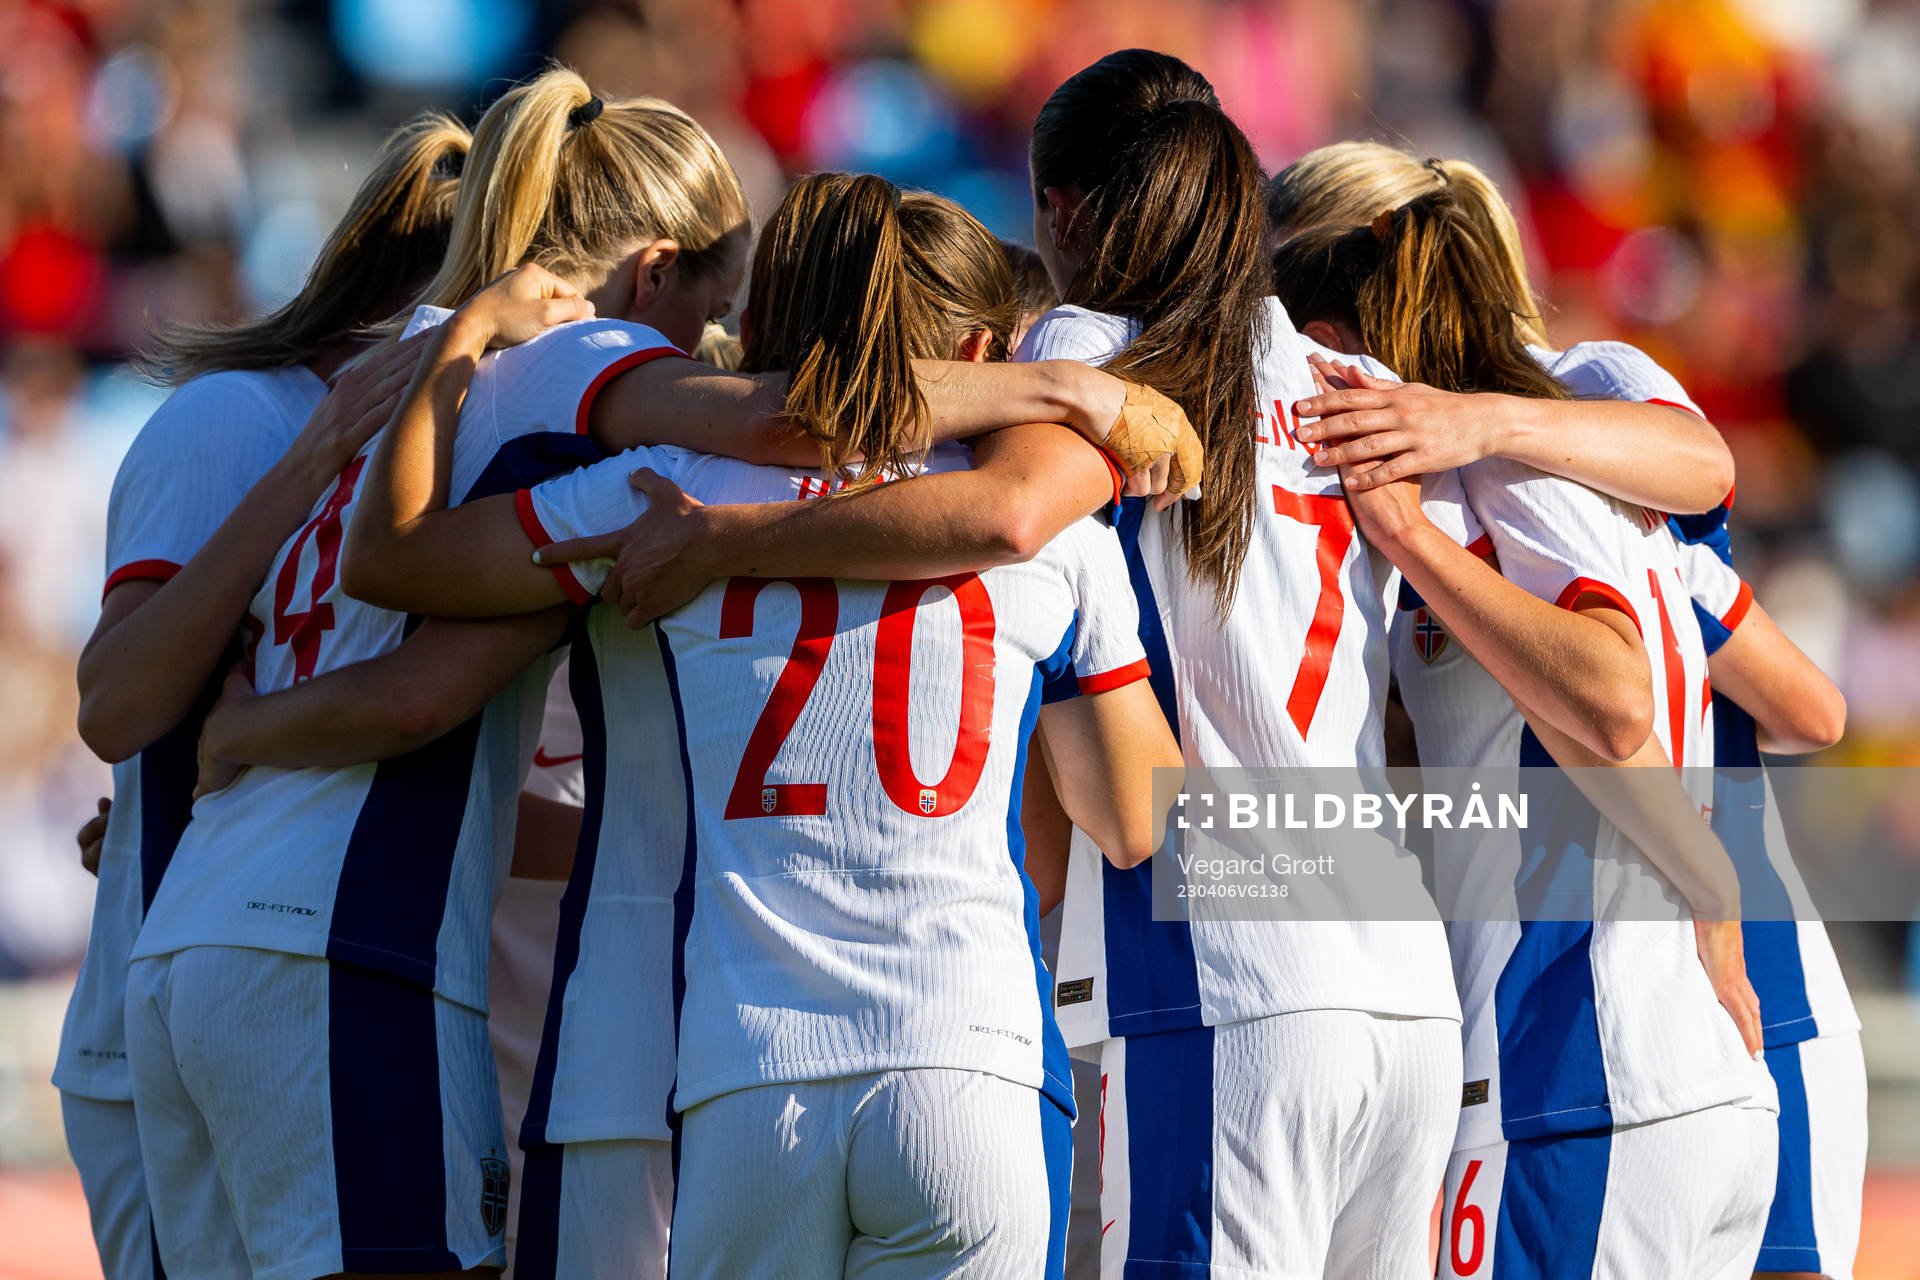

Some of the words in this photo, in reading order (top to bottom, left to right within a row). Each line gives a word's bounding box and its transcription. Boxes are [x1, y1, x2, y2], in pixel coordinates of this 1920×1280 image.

[718, 571, 996, 820] 20
[1272, 484, 1355, 743] 7
[1450, 1160, 1484, 1277] 6
